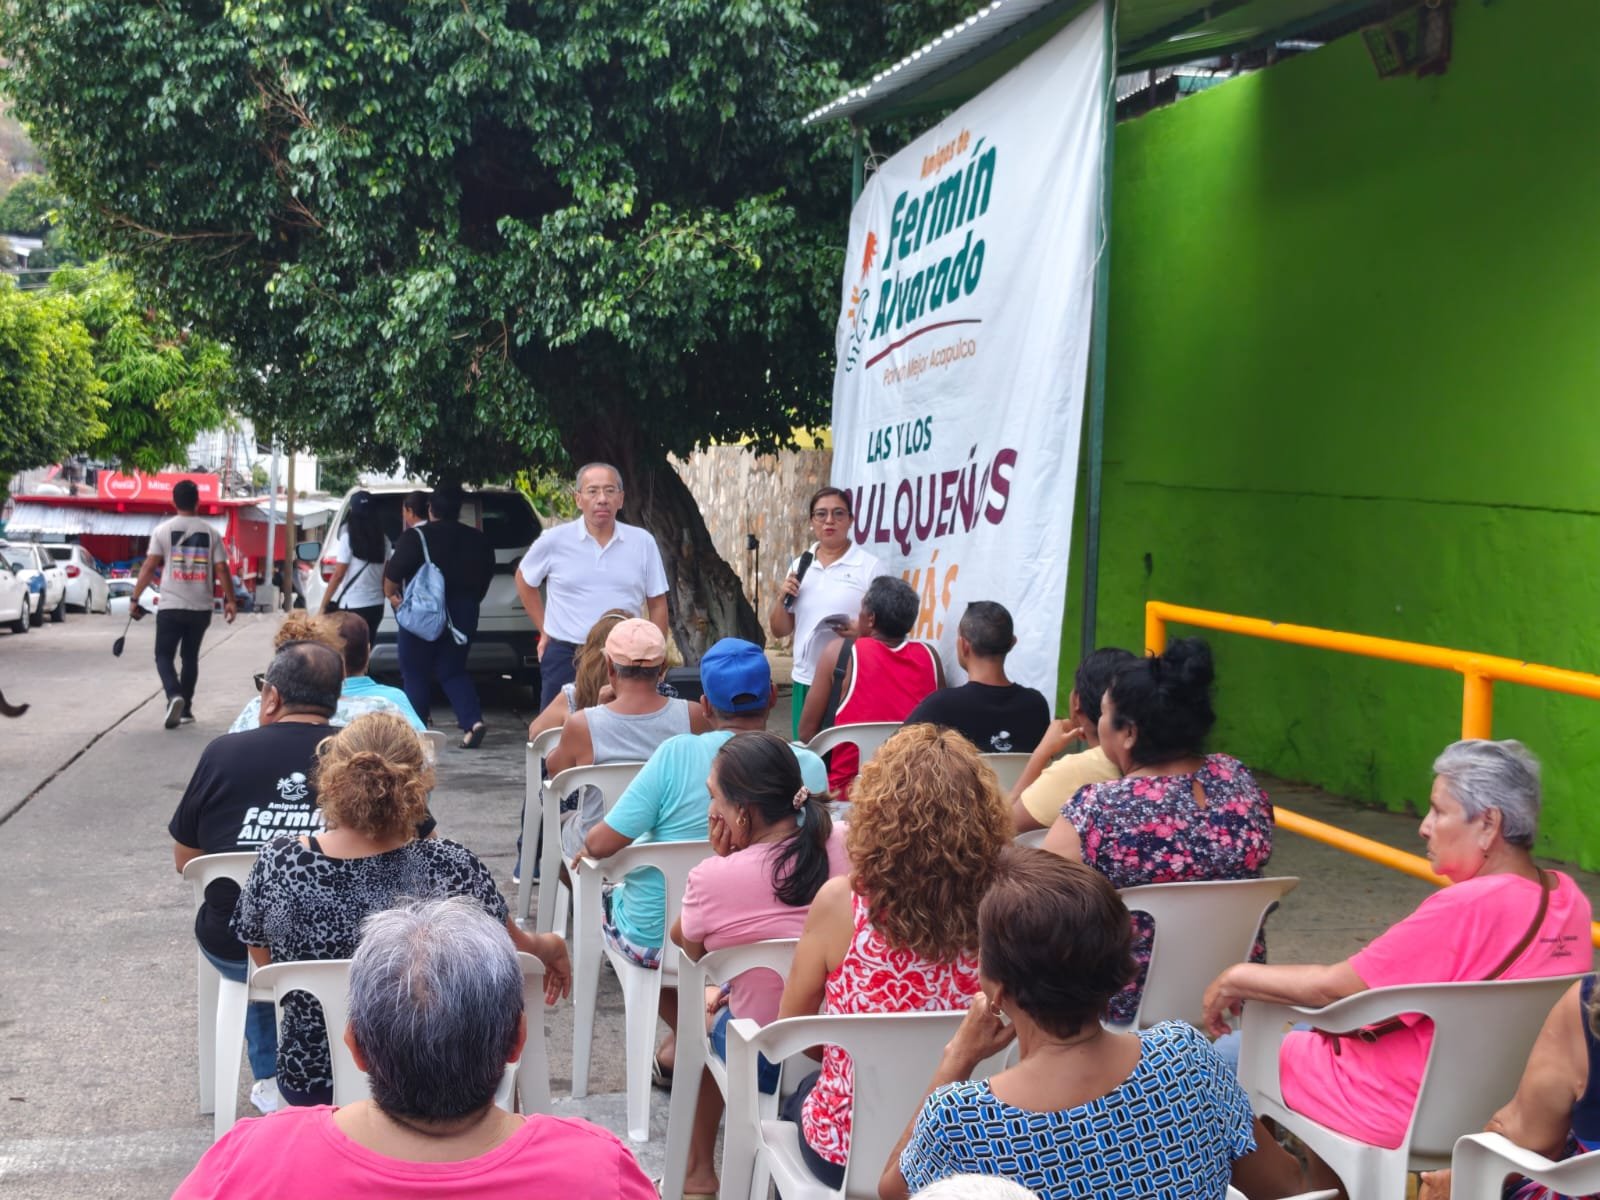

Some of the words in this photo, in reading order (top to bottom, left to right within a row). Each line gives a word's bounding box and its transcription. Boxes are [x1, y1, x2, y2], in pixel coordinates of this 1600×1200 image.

[920, 145, 955, 180] Amigos
[956, 128, 970, 156] de
[882, 137, 997, 272] Fermín
[870, 230, 986, 340] Alvarado
[930, 337, 976, 371] Acapulco
[867, 425, 893, 464] LAS
[896, 423, 905, 458] Y
[905, 415, 932, 454] LOS
[268, 802, 298, 811] Amigos
